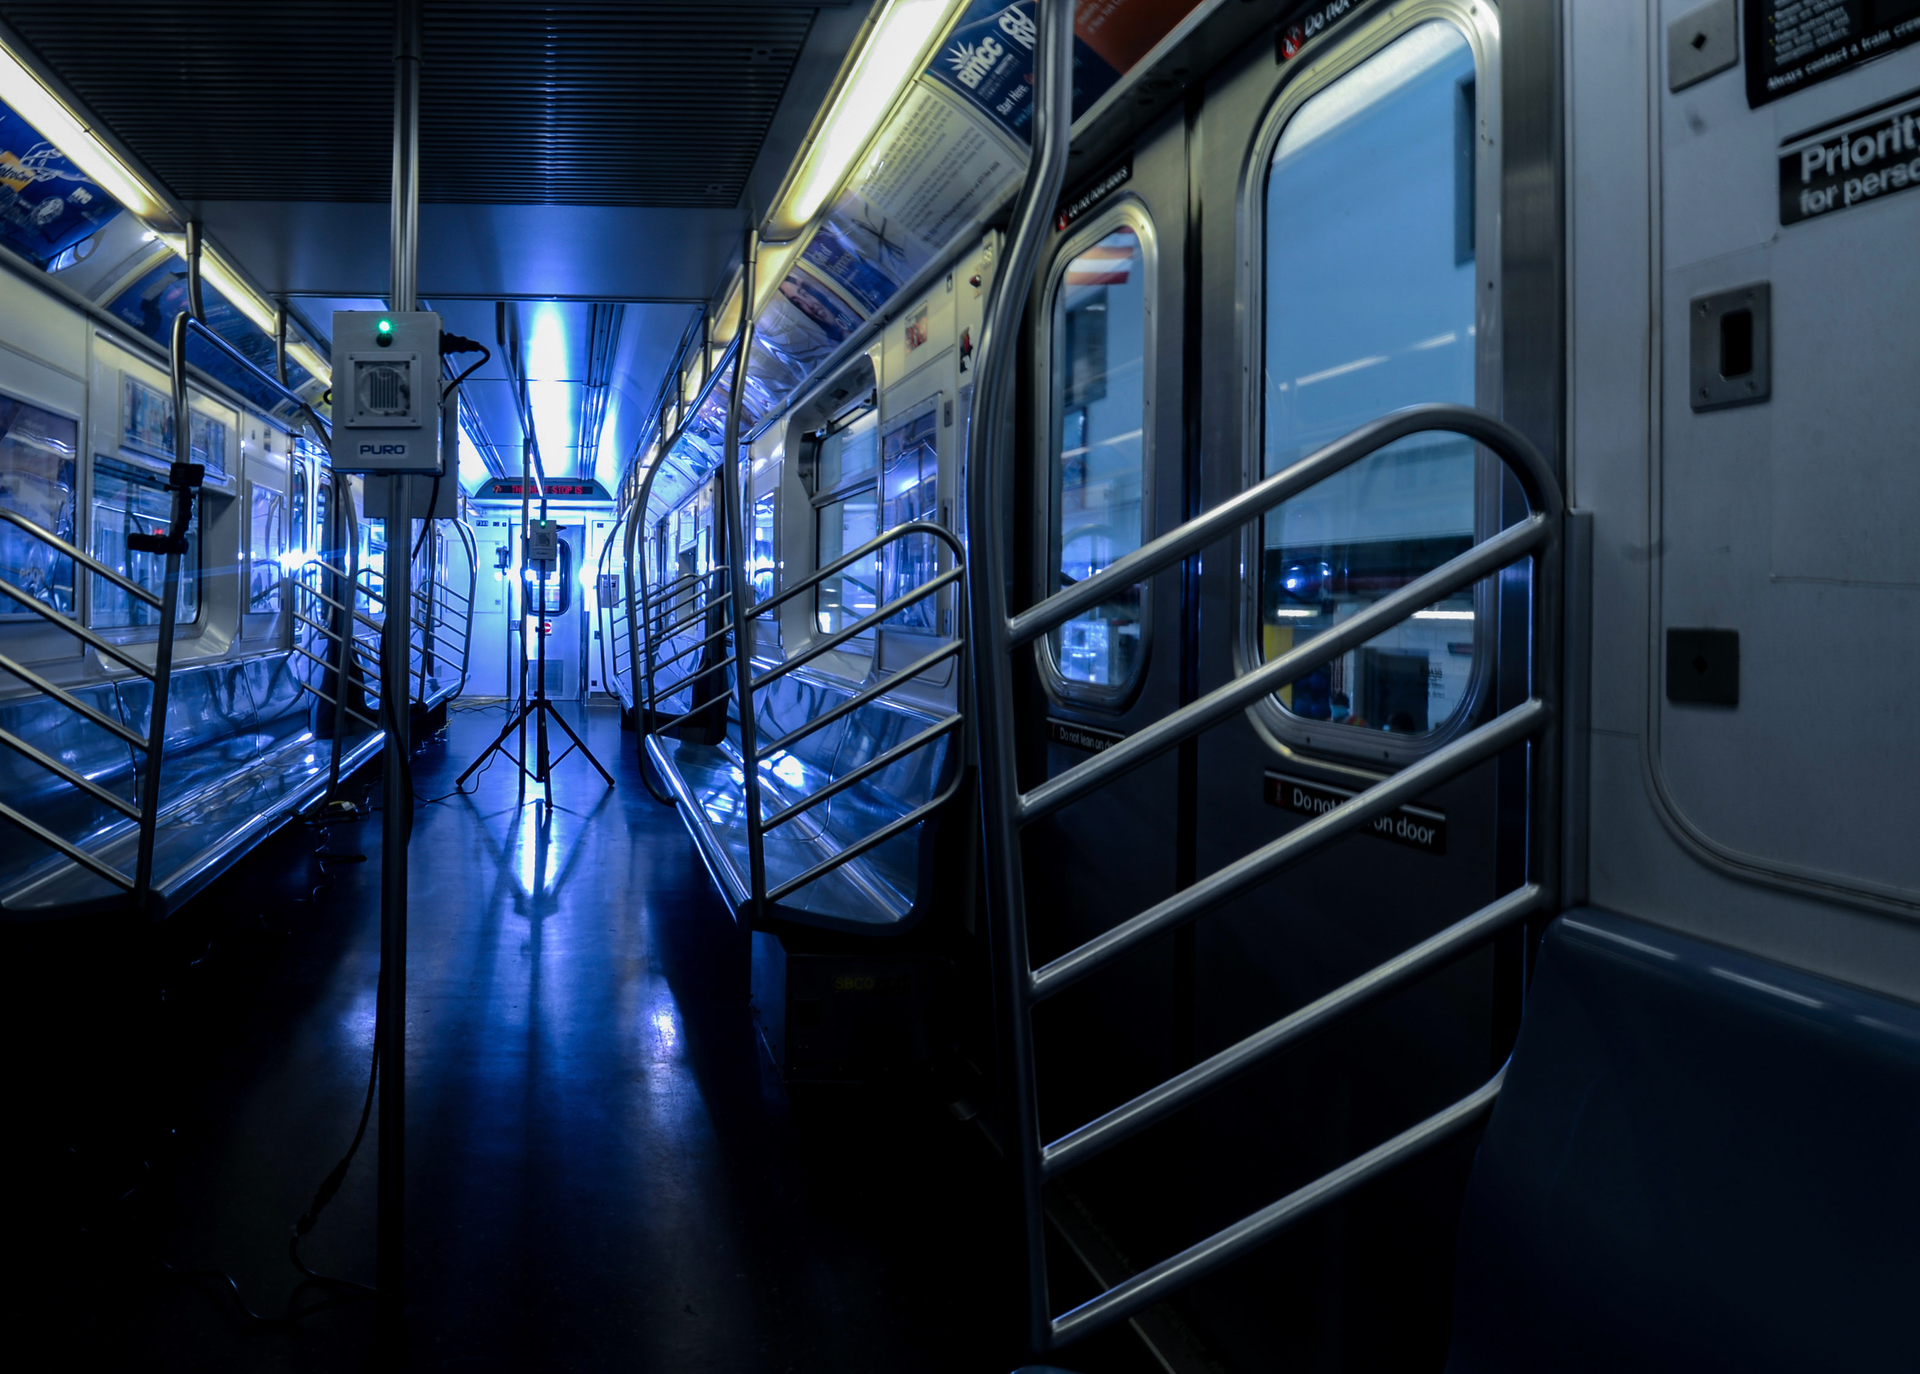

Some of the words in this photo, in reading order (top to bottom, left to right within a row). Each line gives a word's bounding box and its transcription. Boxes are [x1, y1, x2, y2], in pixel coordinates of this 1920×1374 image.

[1304, 12, 1325, 38] Do
[1766, 66, 1804, 92] Always
[1804, 45, 1849, 76] contact
[1850, 43, 1860, 57] a
[1861, 28, 1892, 52] train
[1799, 184, 1838, 216] for
[360, 445, 405, 455] PURO
[552, 486, 572, 494] STOP
[574, 486, 583, 494] IS
[1060, 727, 1069, 741] Do
[1069, 732, 1079, 745] not
[1080, 731, 1095, 749] lean
[1293, 787, 1312, 811] Do
[1396, 816, 1436, 846] door
